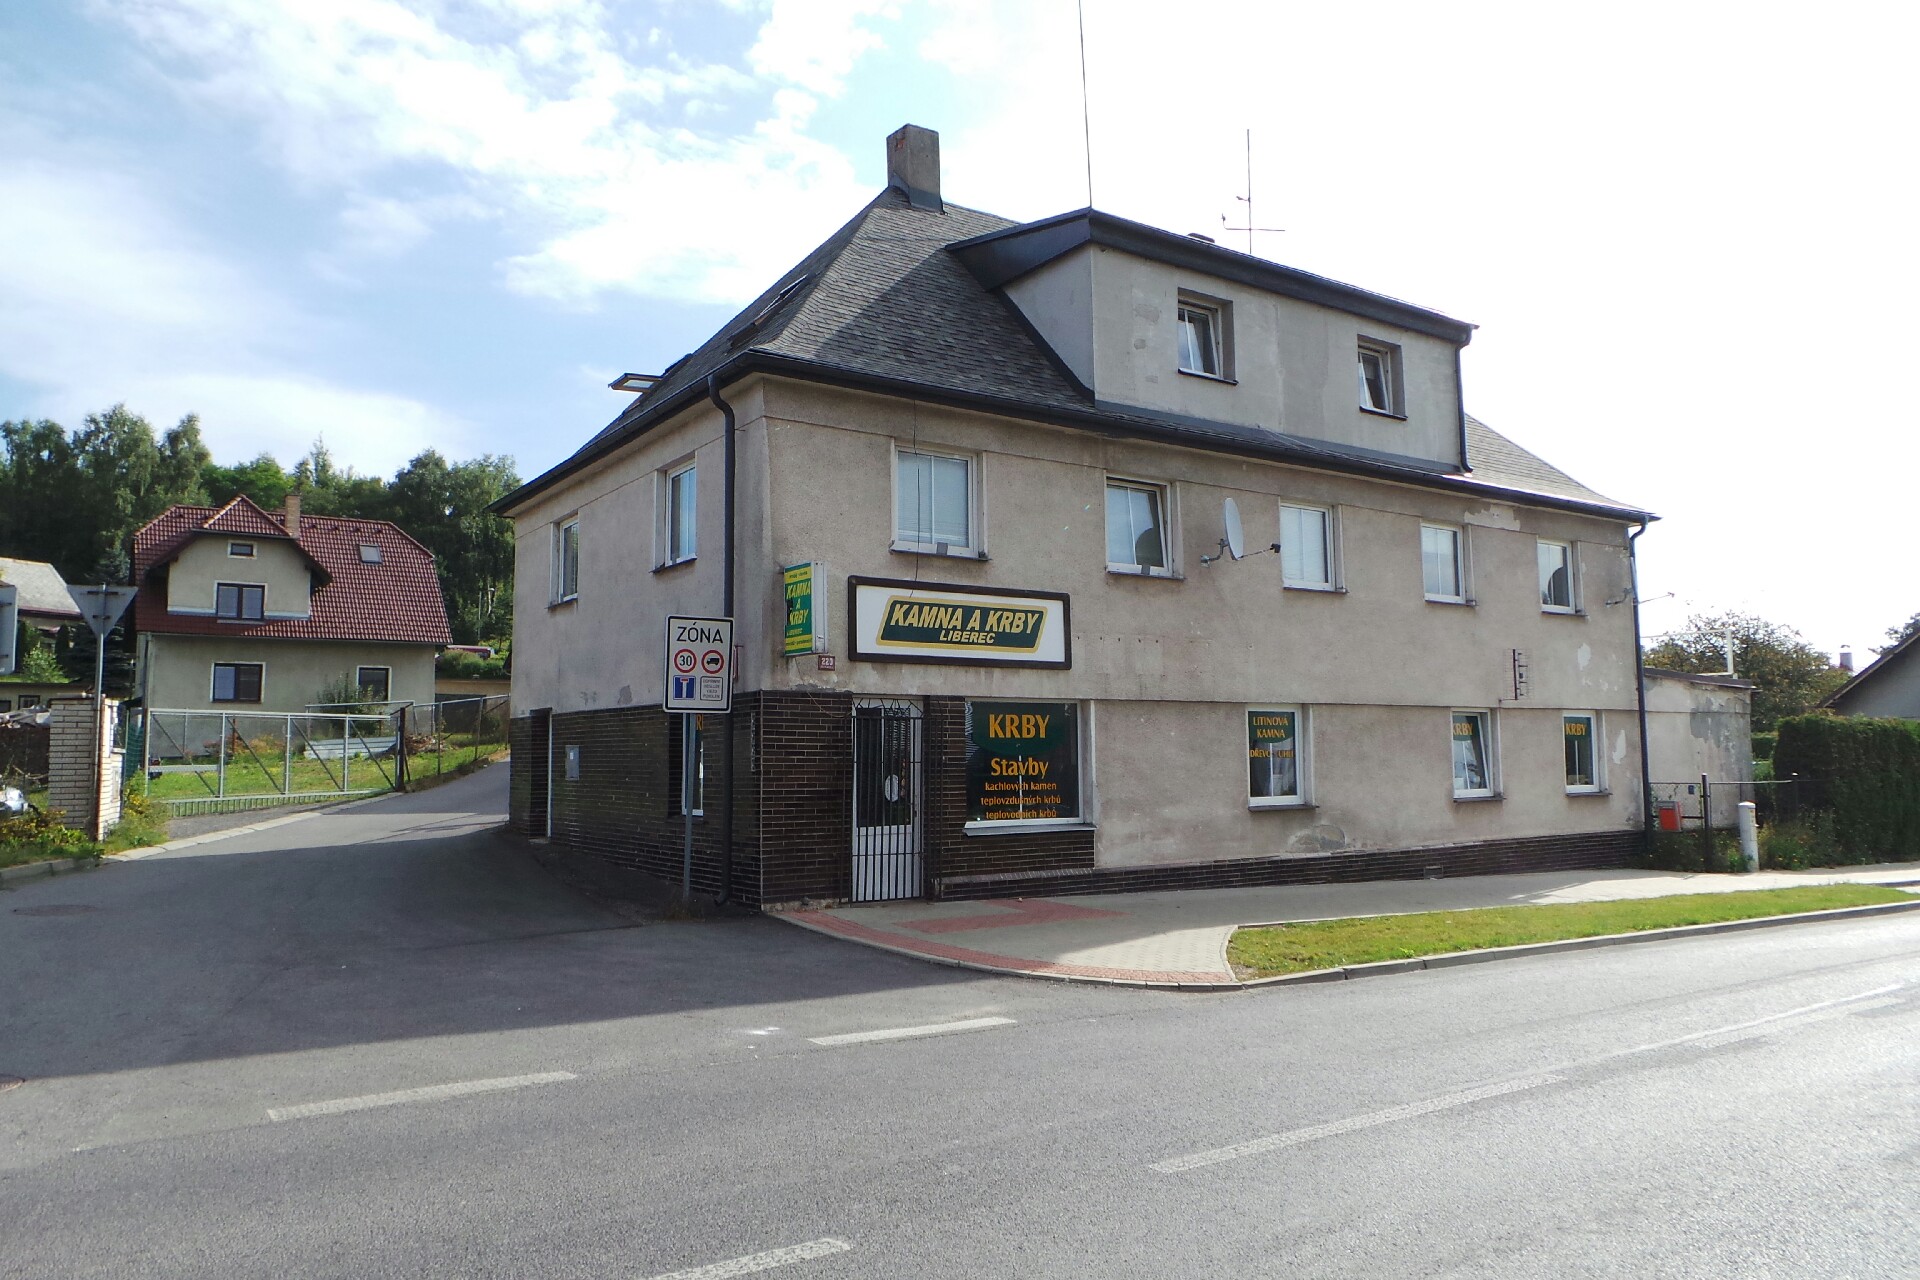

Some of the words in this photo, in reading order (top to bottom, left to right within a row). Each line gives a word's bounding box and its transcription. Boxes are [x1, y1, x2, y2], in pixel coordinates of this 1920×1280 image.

[786, 580, 811, 599] KAMNA
[795, 598, 801, 610] A
[890, 603, 963, 630] KAMNA
[966, 609, 980, 630] A
[985, 610, 1040, 634] KRBY
[676, 621, 723, 643] ZÓNA
[939, 630, 995, 644] LIBEREC
[679, 655, 693, 667] 30
[989, 714, 1050, 739] KRBY
[1256, 729, 1285, 738] KAMNA
[1566, 723, 1586, 736] KRBY
[991, 757, 1049, 780] Stavby
[985, 781, 1028, 792] kachlových
[1030, 781, 1057, 790] kamen
